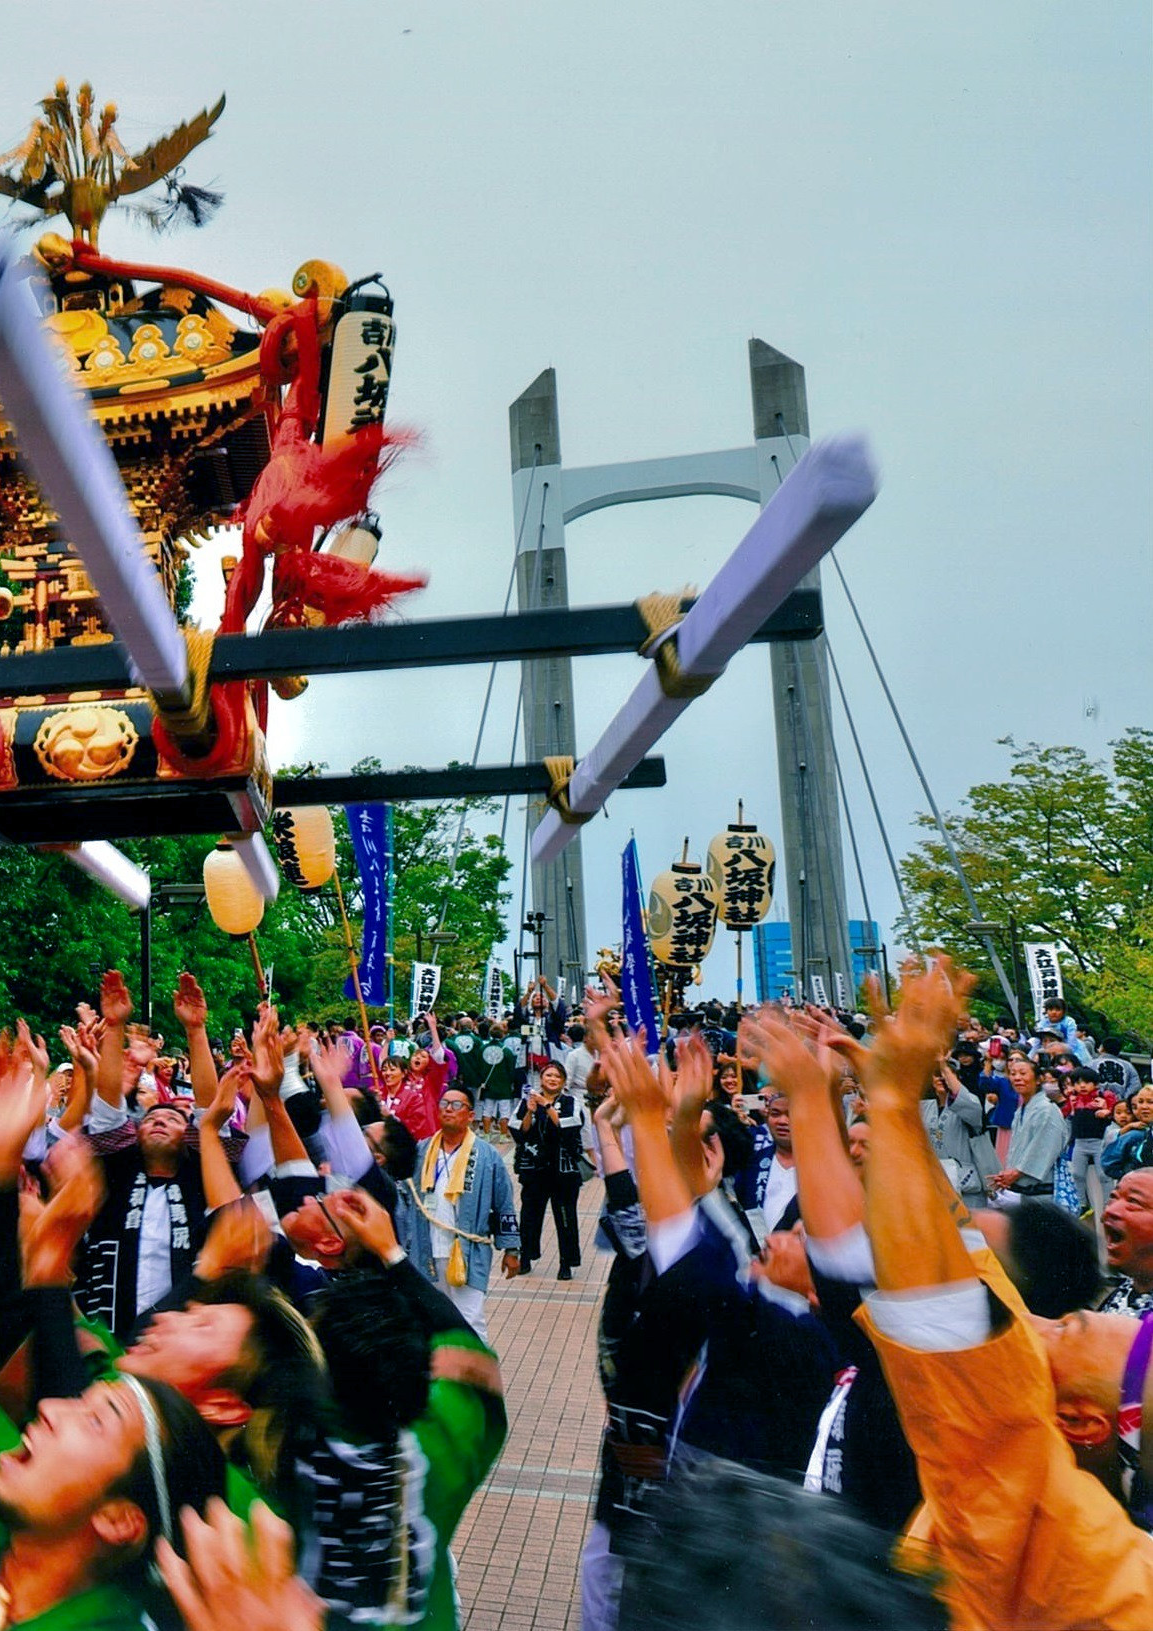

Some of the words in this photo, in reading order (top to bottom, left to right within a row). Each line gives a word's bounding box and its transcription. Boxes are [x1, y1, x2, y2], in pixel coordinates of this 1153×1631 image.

[725, 836, 766, 850] 吉川
[673, 877, 714, 893] 吉川
[723, 848, 768, 923] 八坂神社
[667, 890, 716, 964] 八坂神社
[1034, 948, 1059, 1014] 大江戸神輿
